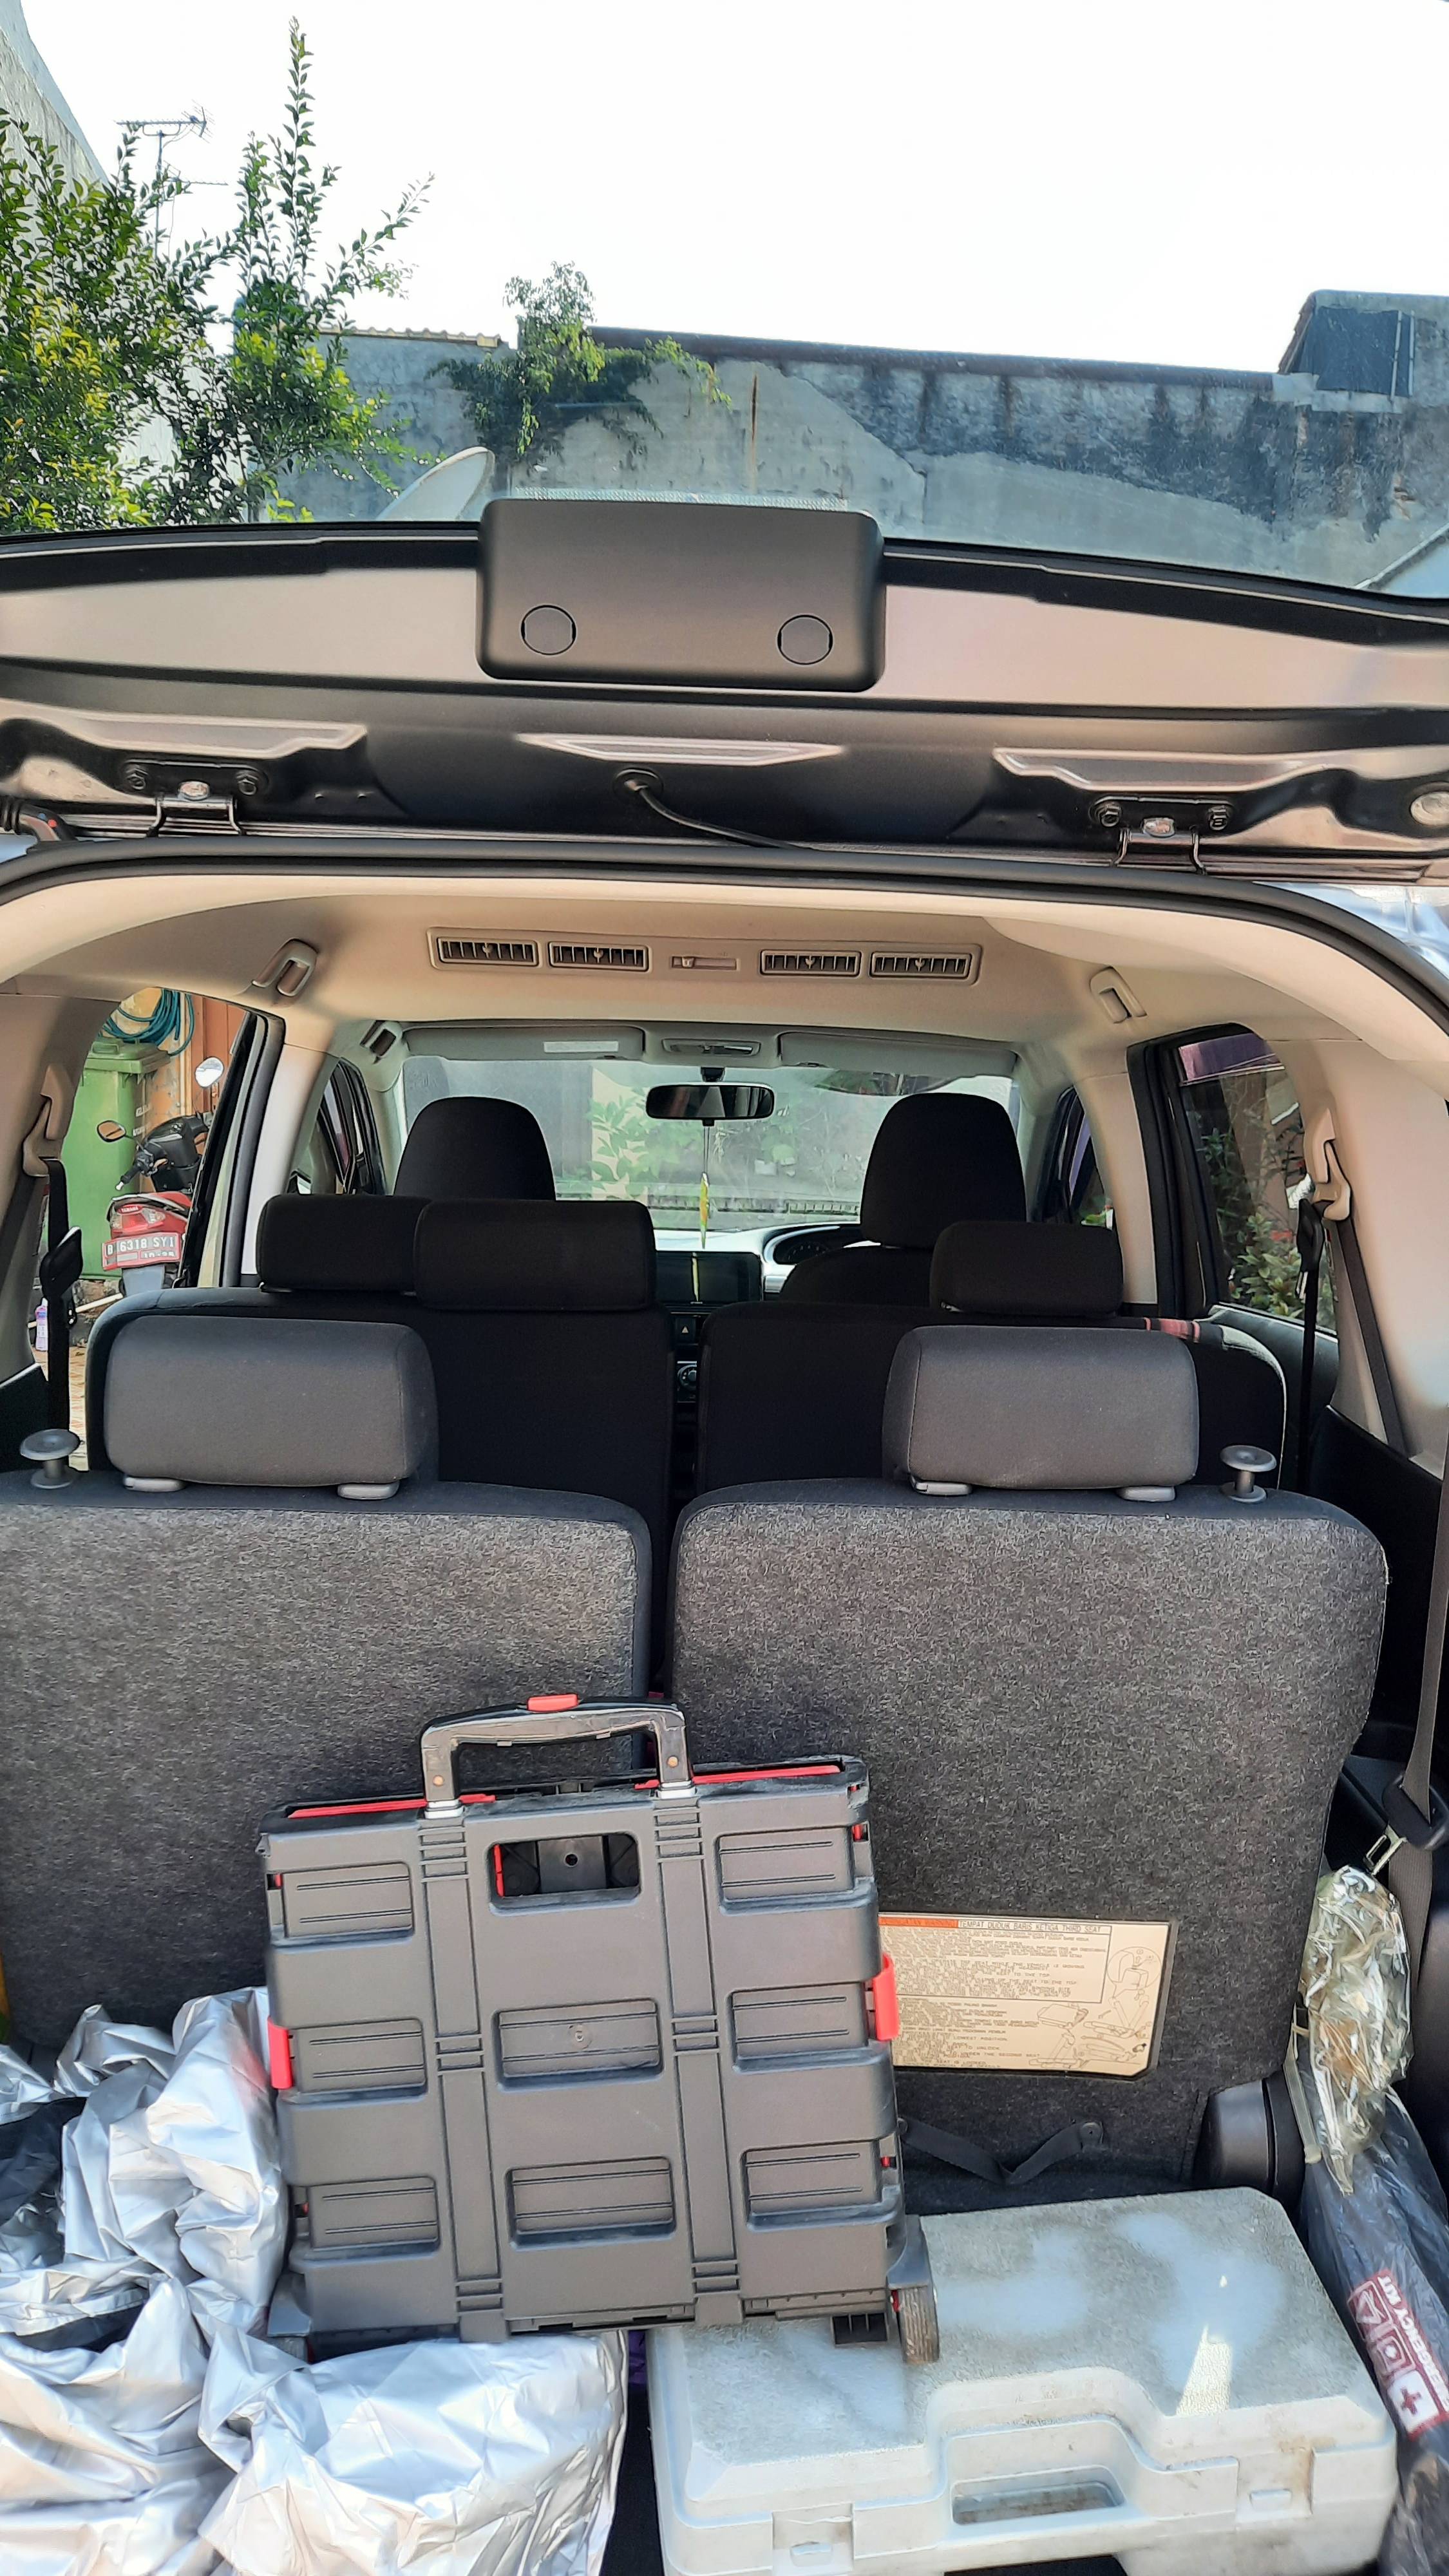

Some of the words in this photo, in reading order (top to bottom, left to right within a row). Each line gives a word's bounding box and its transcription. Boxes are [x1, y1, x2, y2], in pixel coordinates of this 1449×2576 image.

[107, 1244, 113, 1255] B
[120, 1238, 147, 1252] 6318
[1377, 2276, 1402, 2306] KIT
